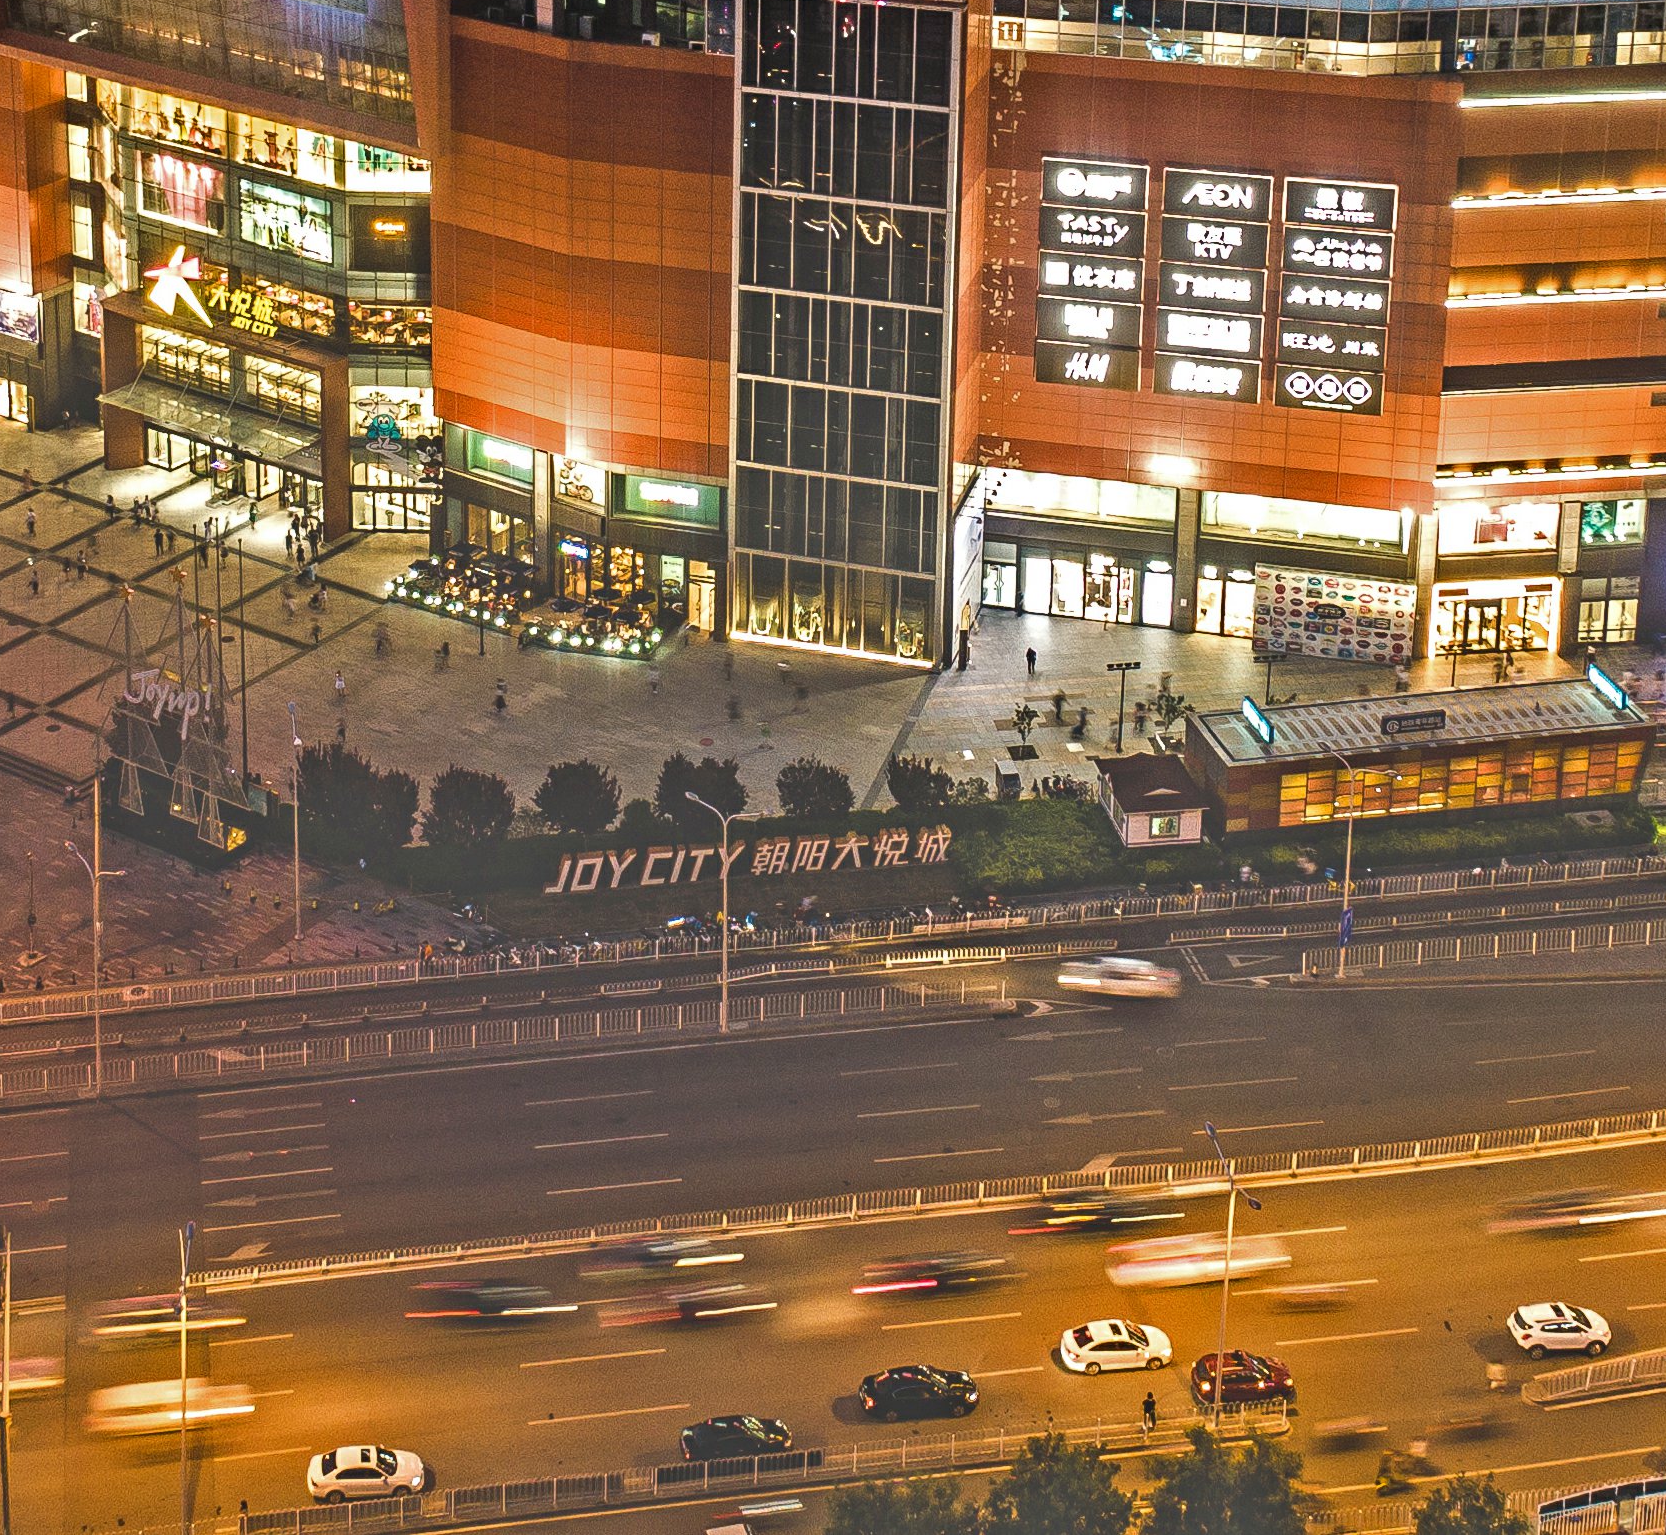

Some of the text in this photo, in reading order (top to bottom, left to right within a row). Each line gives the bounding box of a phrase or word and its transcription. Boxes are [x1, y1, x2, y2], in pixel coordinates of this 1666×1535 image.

[1195, 242, 1233, 259] KTV
[208, 284, 274, 325] 大悦城
[230, 315, 279, 338] JOY CITY
[544, 824, 953, 894] JOY CITY 朝阳大悦城
